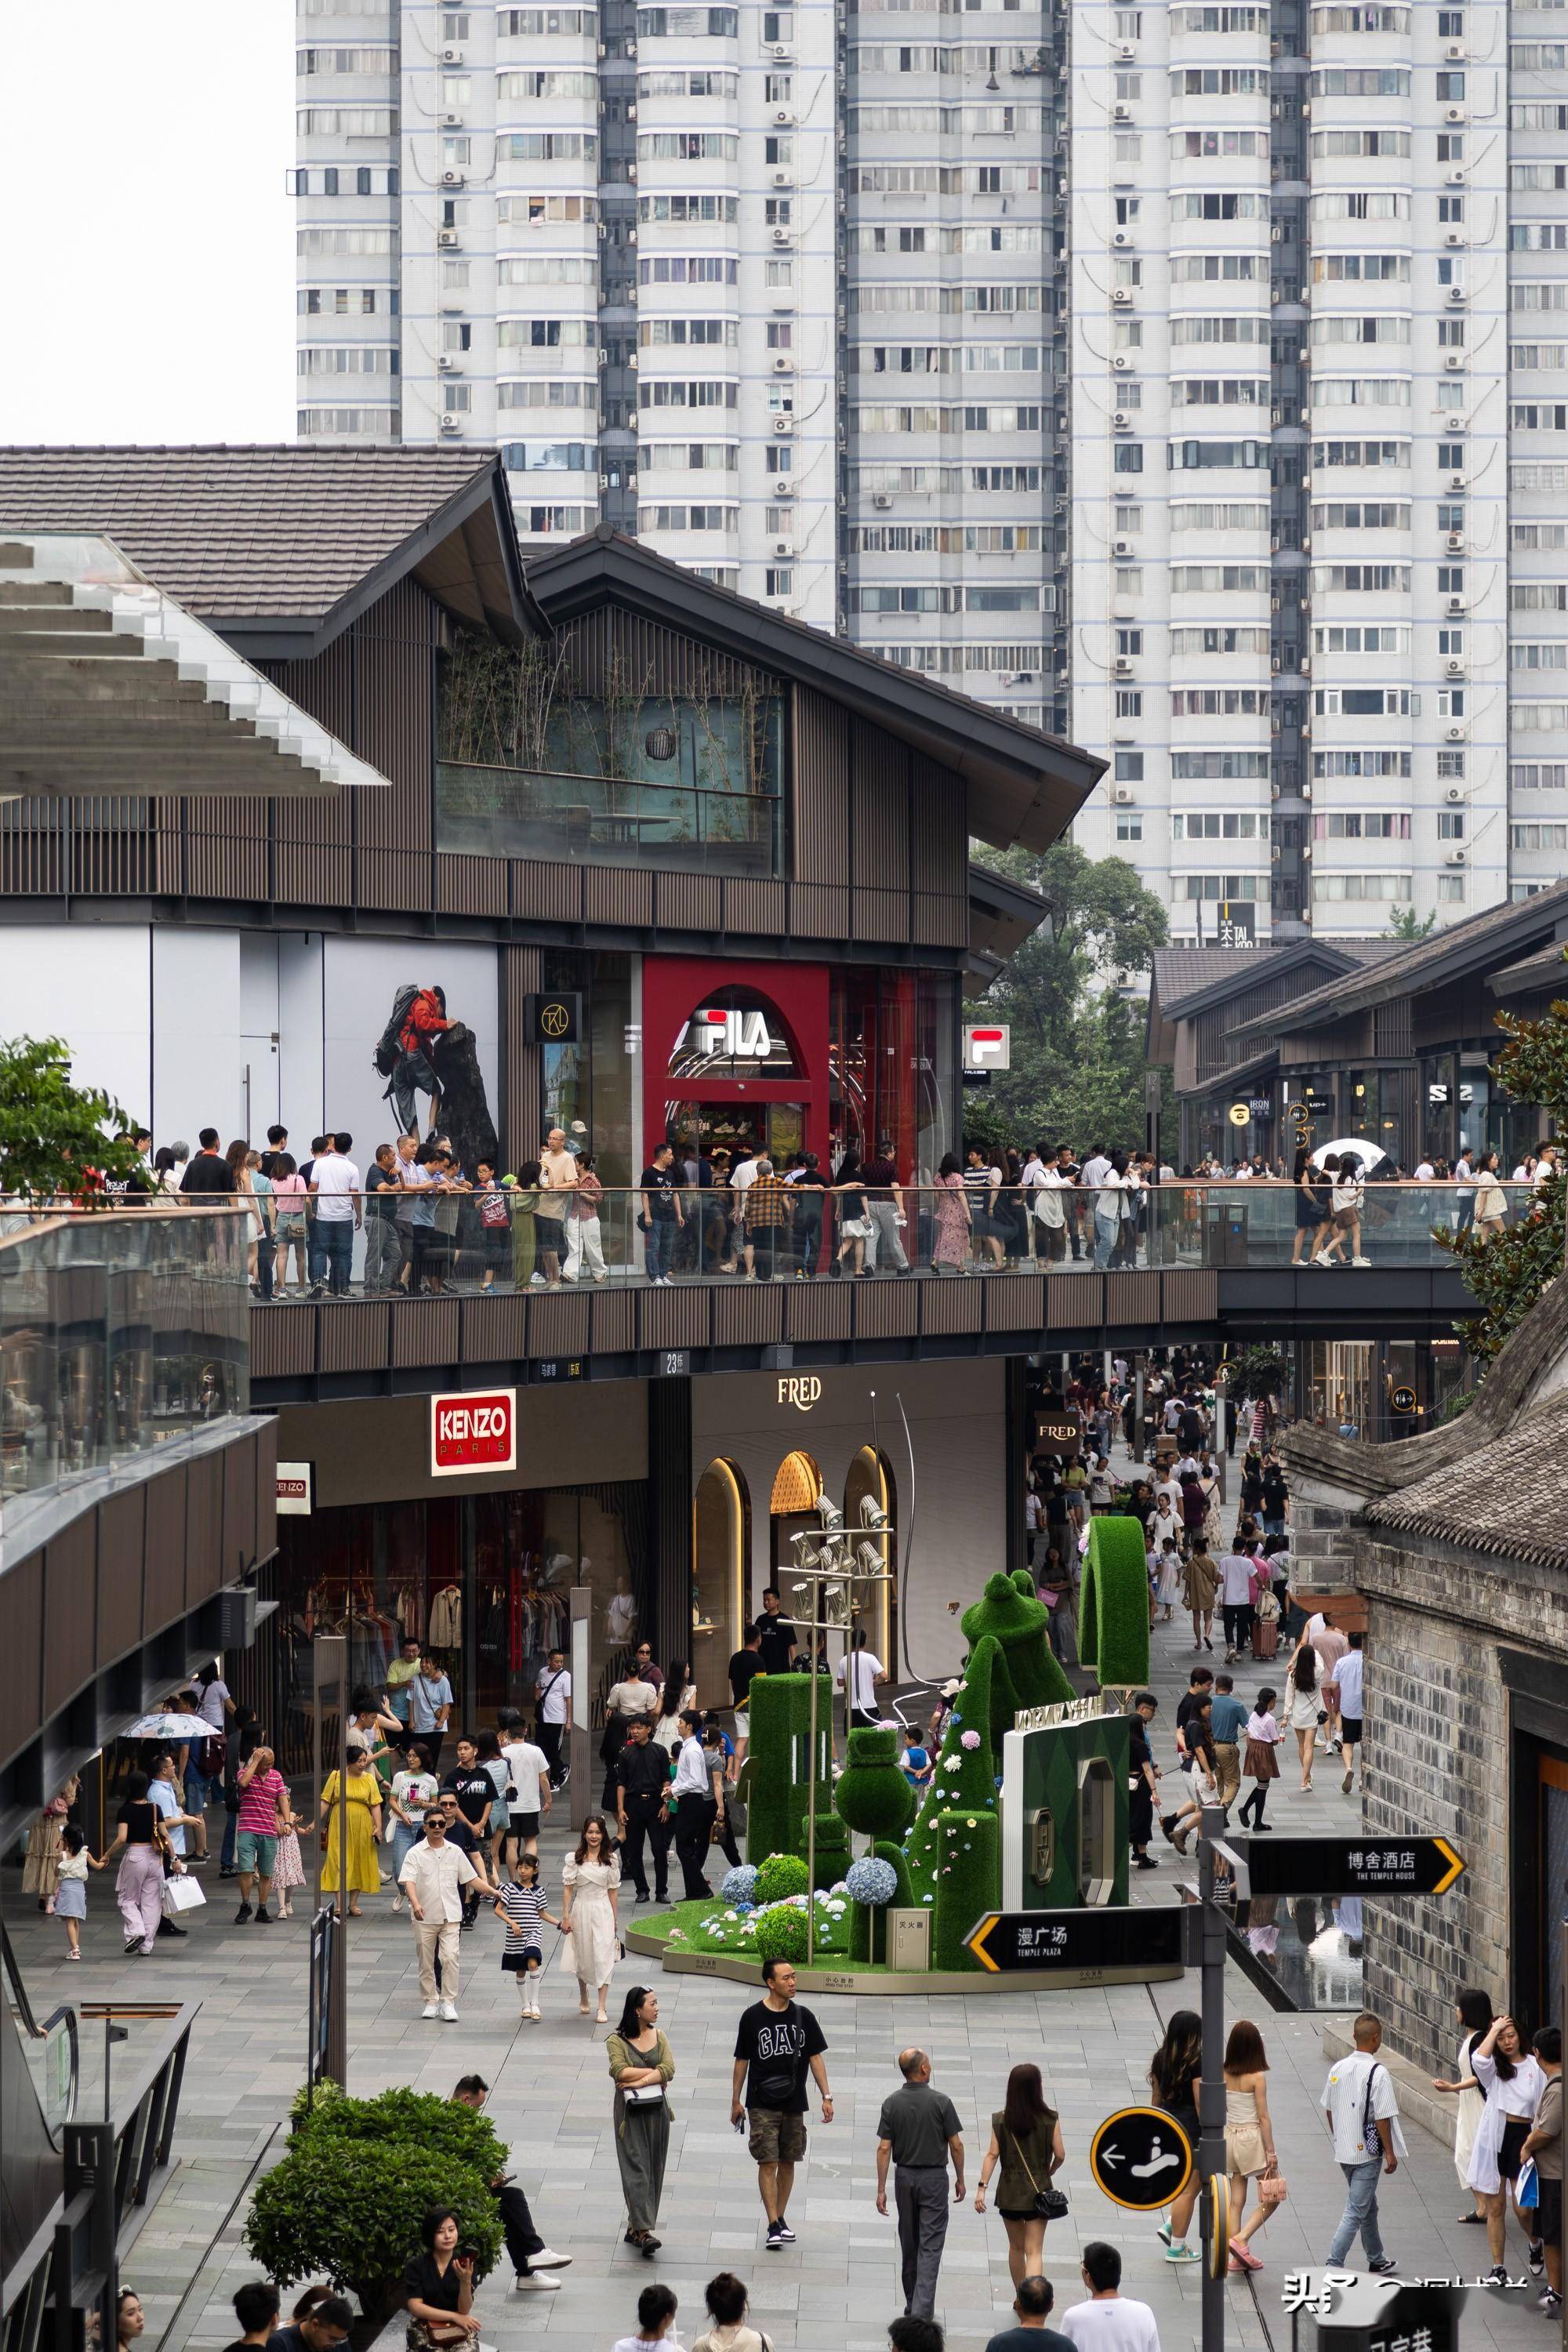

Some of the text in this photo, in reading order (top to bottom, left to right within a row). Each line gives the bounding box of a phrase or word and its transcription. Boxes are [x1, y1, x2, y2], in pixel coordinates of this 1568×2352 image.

[1233, 926, 1247, 941] TAI
[706, 1010, 771, 1056] FILA
[778, 1377, 822, 1411] FRED
[440, 1406, 506, 1441] KENZO
[1039, 1425, 1076, 1440] FRED
[440, 1441, 506, 1456] PARIS
[277, 1482, 304, 1492] ENZO
[1348, 1851, 1416, 1869] 博舍酒店
[1357, 1871, 1416, 1880] THE TEMPLE HOUSE
[1018, 1926, 1068, 1946] 漫广场
[1018, 1947, 1062, 1957] TEMPLE PLAZA
[77, 2136, 99, 2167] L1
